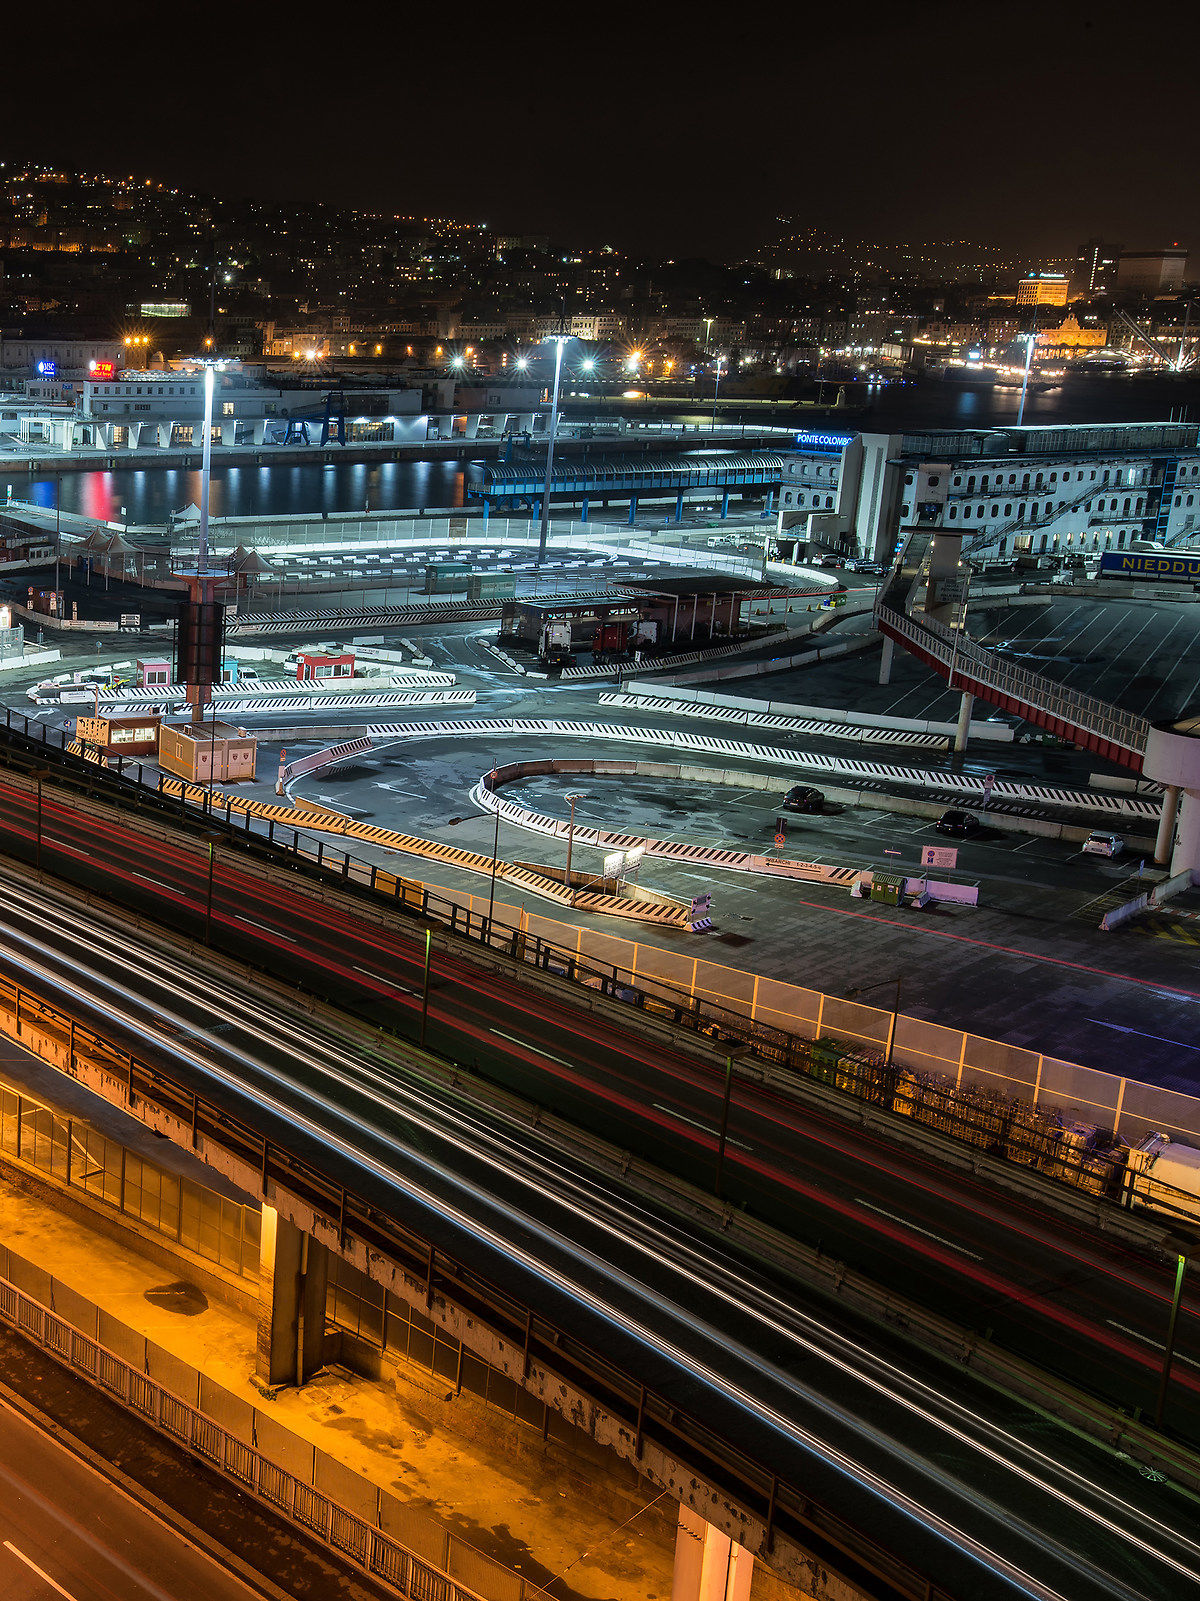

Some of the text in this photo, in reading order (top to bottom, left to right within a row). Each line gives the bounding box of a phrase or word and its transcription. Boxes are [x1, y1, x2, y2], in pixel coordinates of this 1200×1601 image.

[44, 362, 55, 371] MSC
[797, 433, 819, 444] PONTE
[1122, 558, 1200, 574] NIEDDU
[765, 857, 791, 866] IMBARCHI
